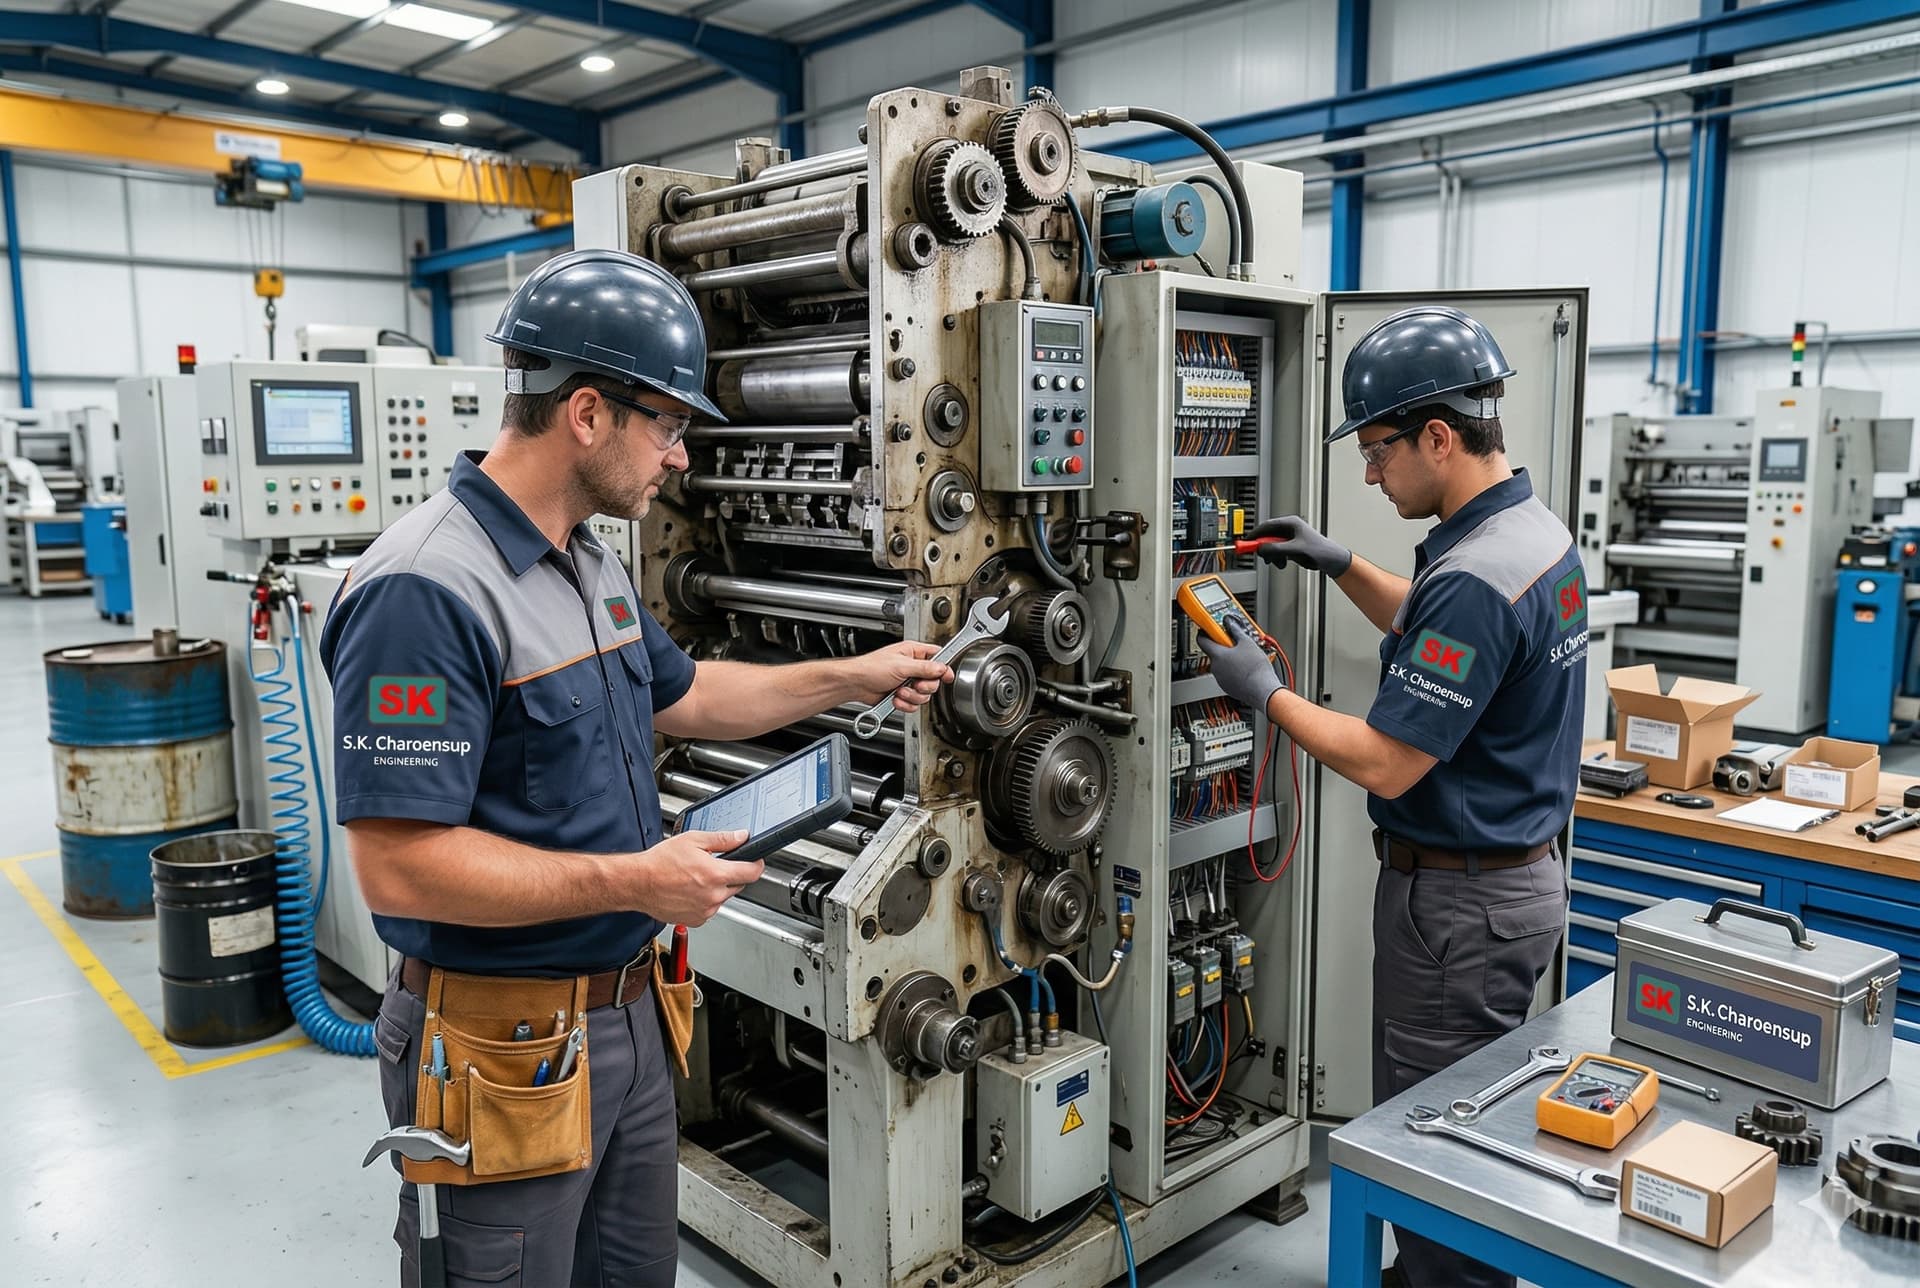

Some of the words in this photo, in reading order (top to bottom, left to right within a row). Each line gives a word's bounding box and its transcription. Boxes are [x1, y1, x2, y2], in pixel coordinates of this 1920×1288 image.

[610, 604, 633, 623] SK
[1560, 577, 1583, 621] SK
[1420, 639, 1467, 674] SK
[378, 684, 437, 717] SK
[1389, 664, 1407, 681] S.K.
[1410, 673, 1473, 709] Charoensup
[343, 735, 372, 750] S.K.
[376, 735, 471, 756] Charoensup
[374, 756, 438, 767] ENGINEERING
[1641, 983, 1674, 1015] SK
[1686, 1018, 1743, 1042] ENGINEERING
[1687, 994, 1715, 1018] S.K.
[1718, 1005, 1812, 1049] Charoensup
